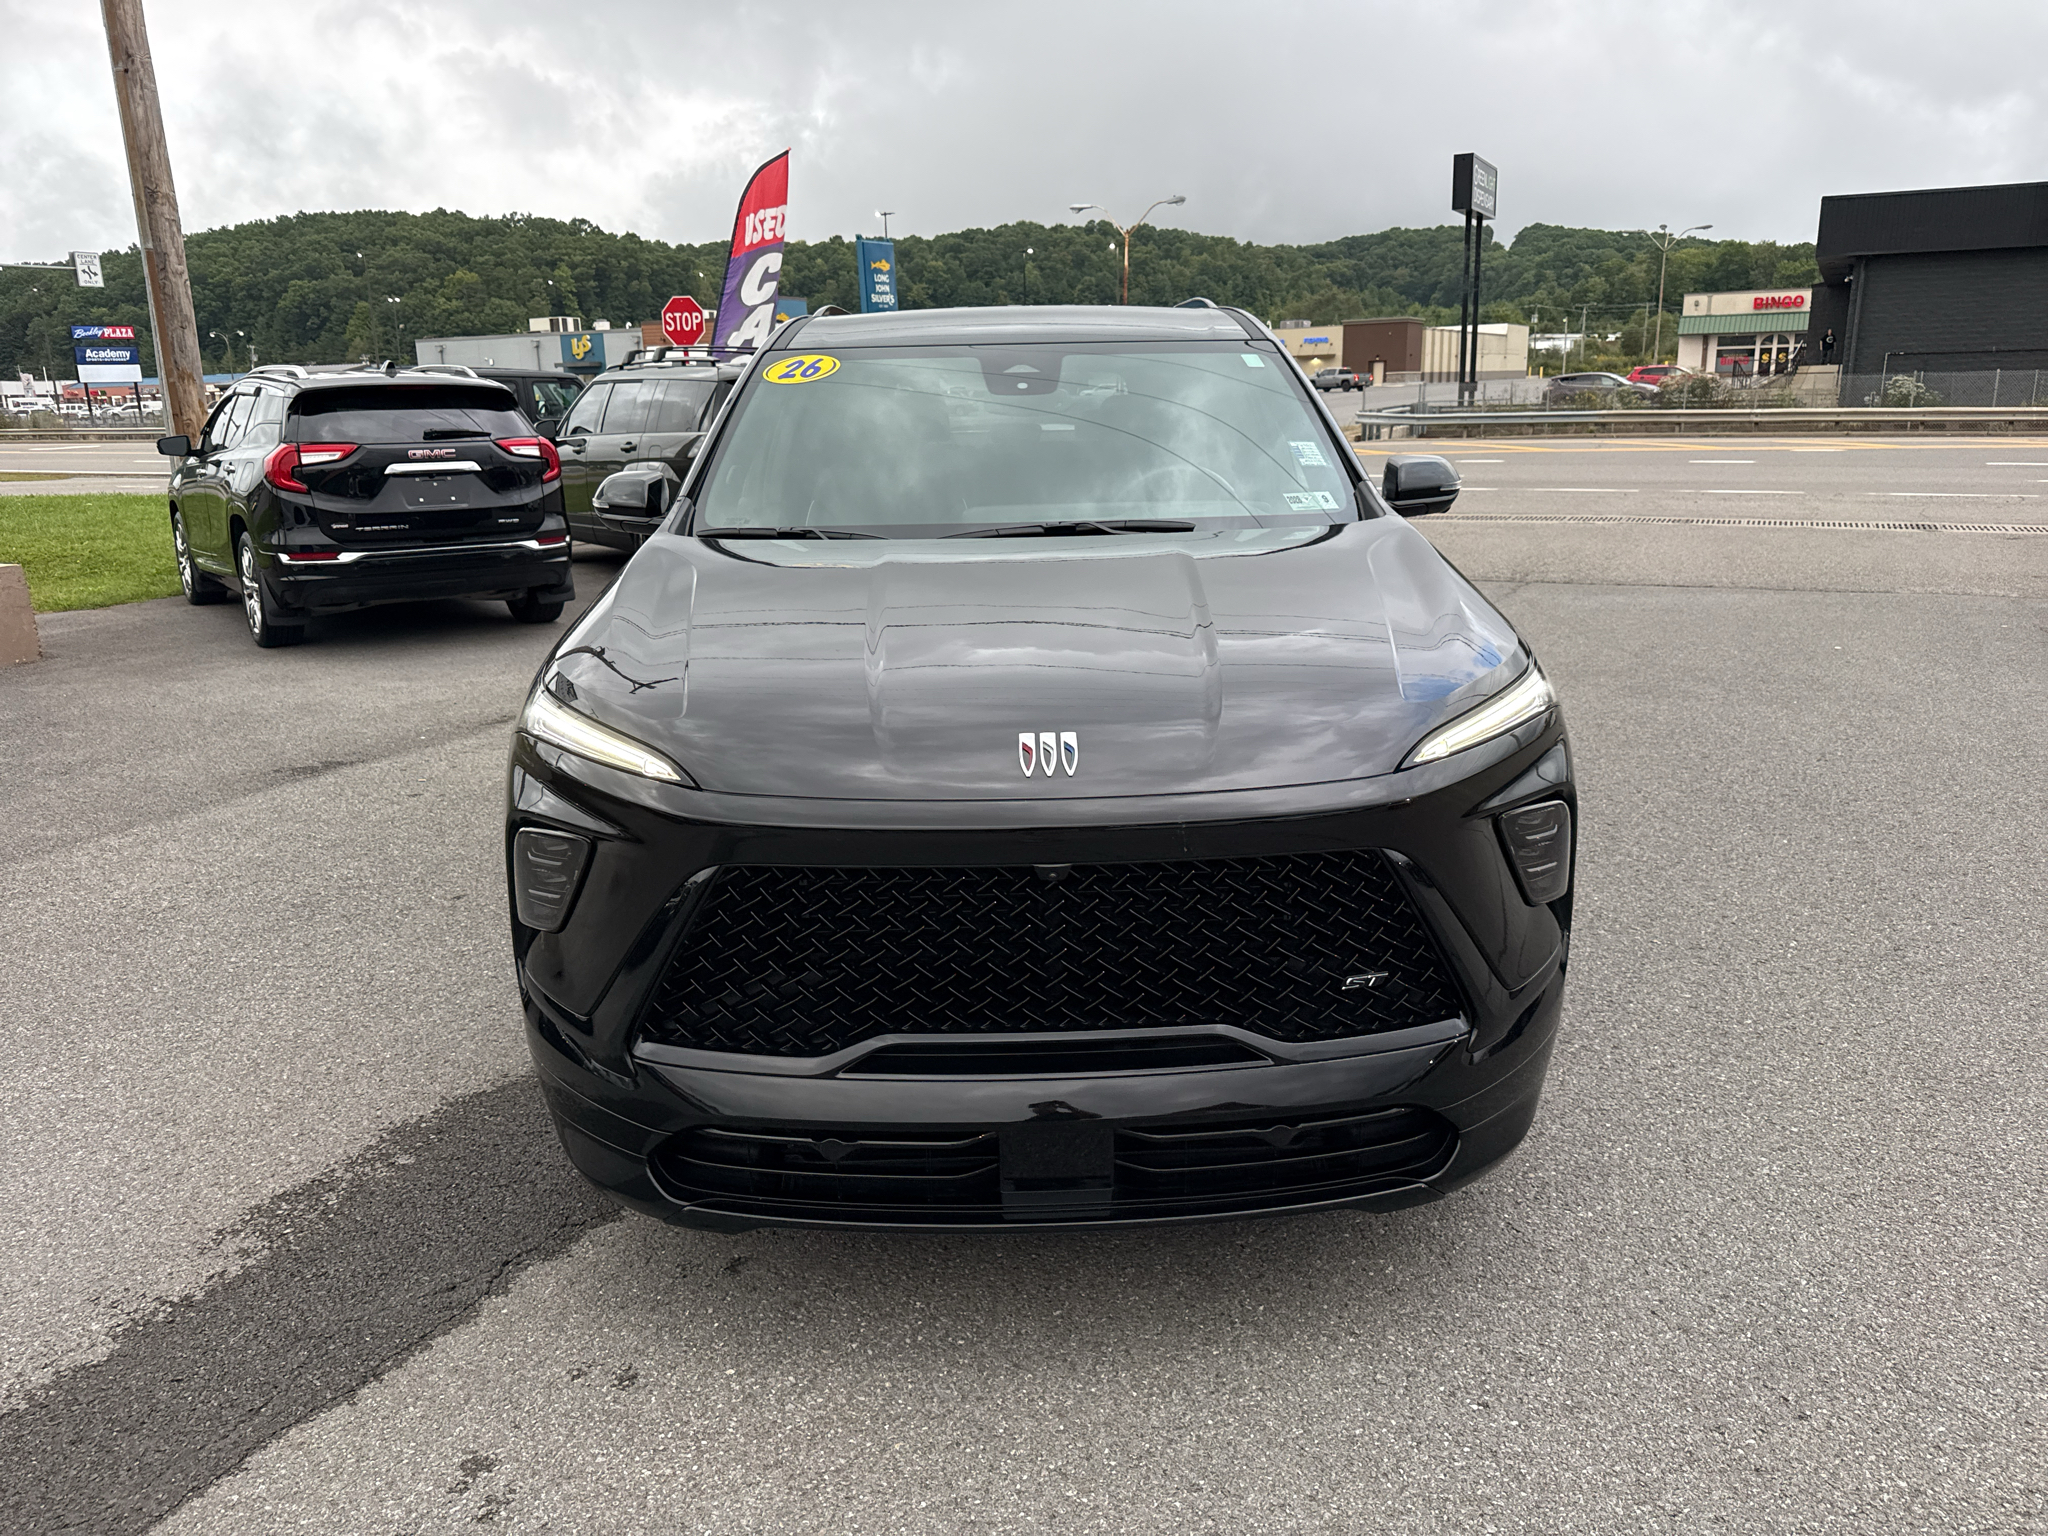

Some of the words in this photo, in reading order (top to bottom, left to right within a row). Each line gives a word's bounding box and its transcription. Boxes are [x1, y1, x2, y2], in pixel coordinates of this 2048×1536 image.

[745, 204, 787, 247] USED
[873, 273, 890, 283] LONG
[875, 283, 891, 293] JOHN
[870, 293, 895, 307] SILVER'S
[1753, 295, 1805, 310] BINGO
[727, 252, 783, 364] CA
[665, 311, 702, 332] STOP
[73, 326, 104, 339] Beckley
[103, 328, 135, 338] PLAZA
[85, 348, 131, 361] Academy
[777, 358, 824, 380] 26
[407, 449, 457, 460] GMC
[355, 524, 409, 532] TERRAIN
